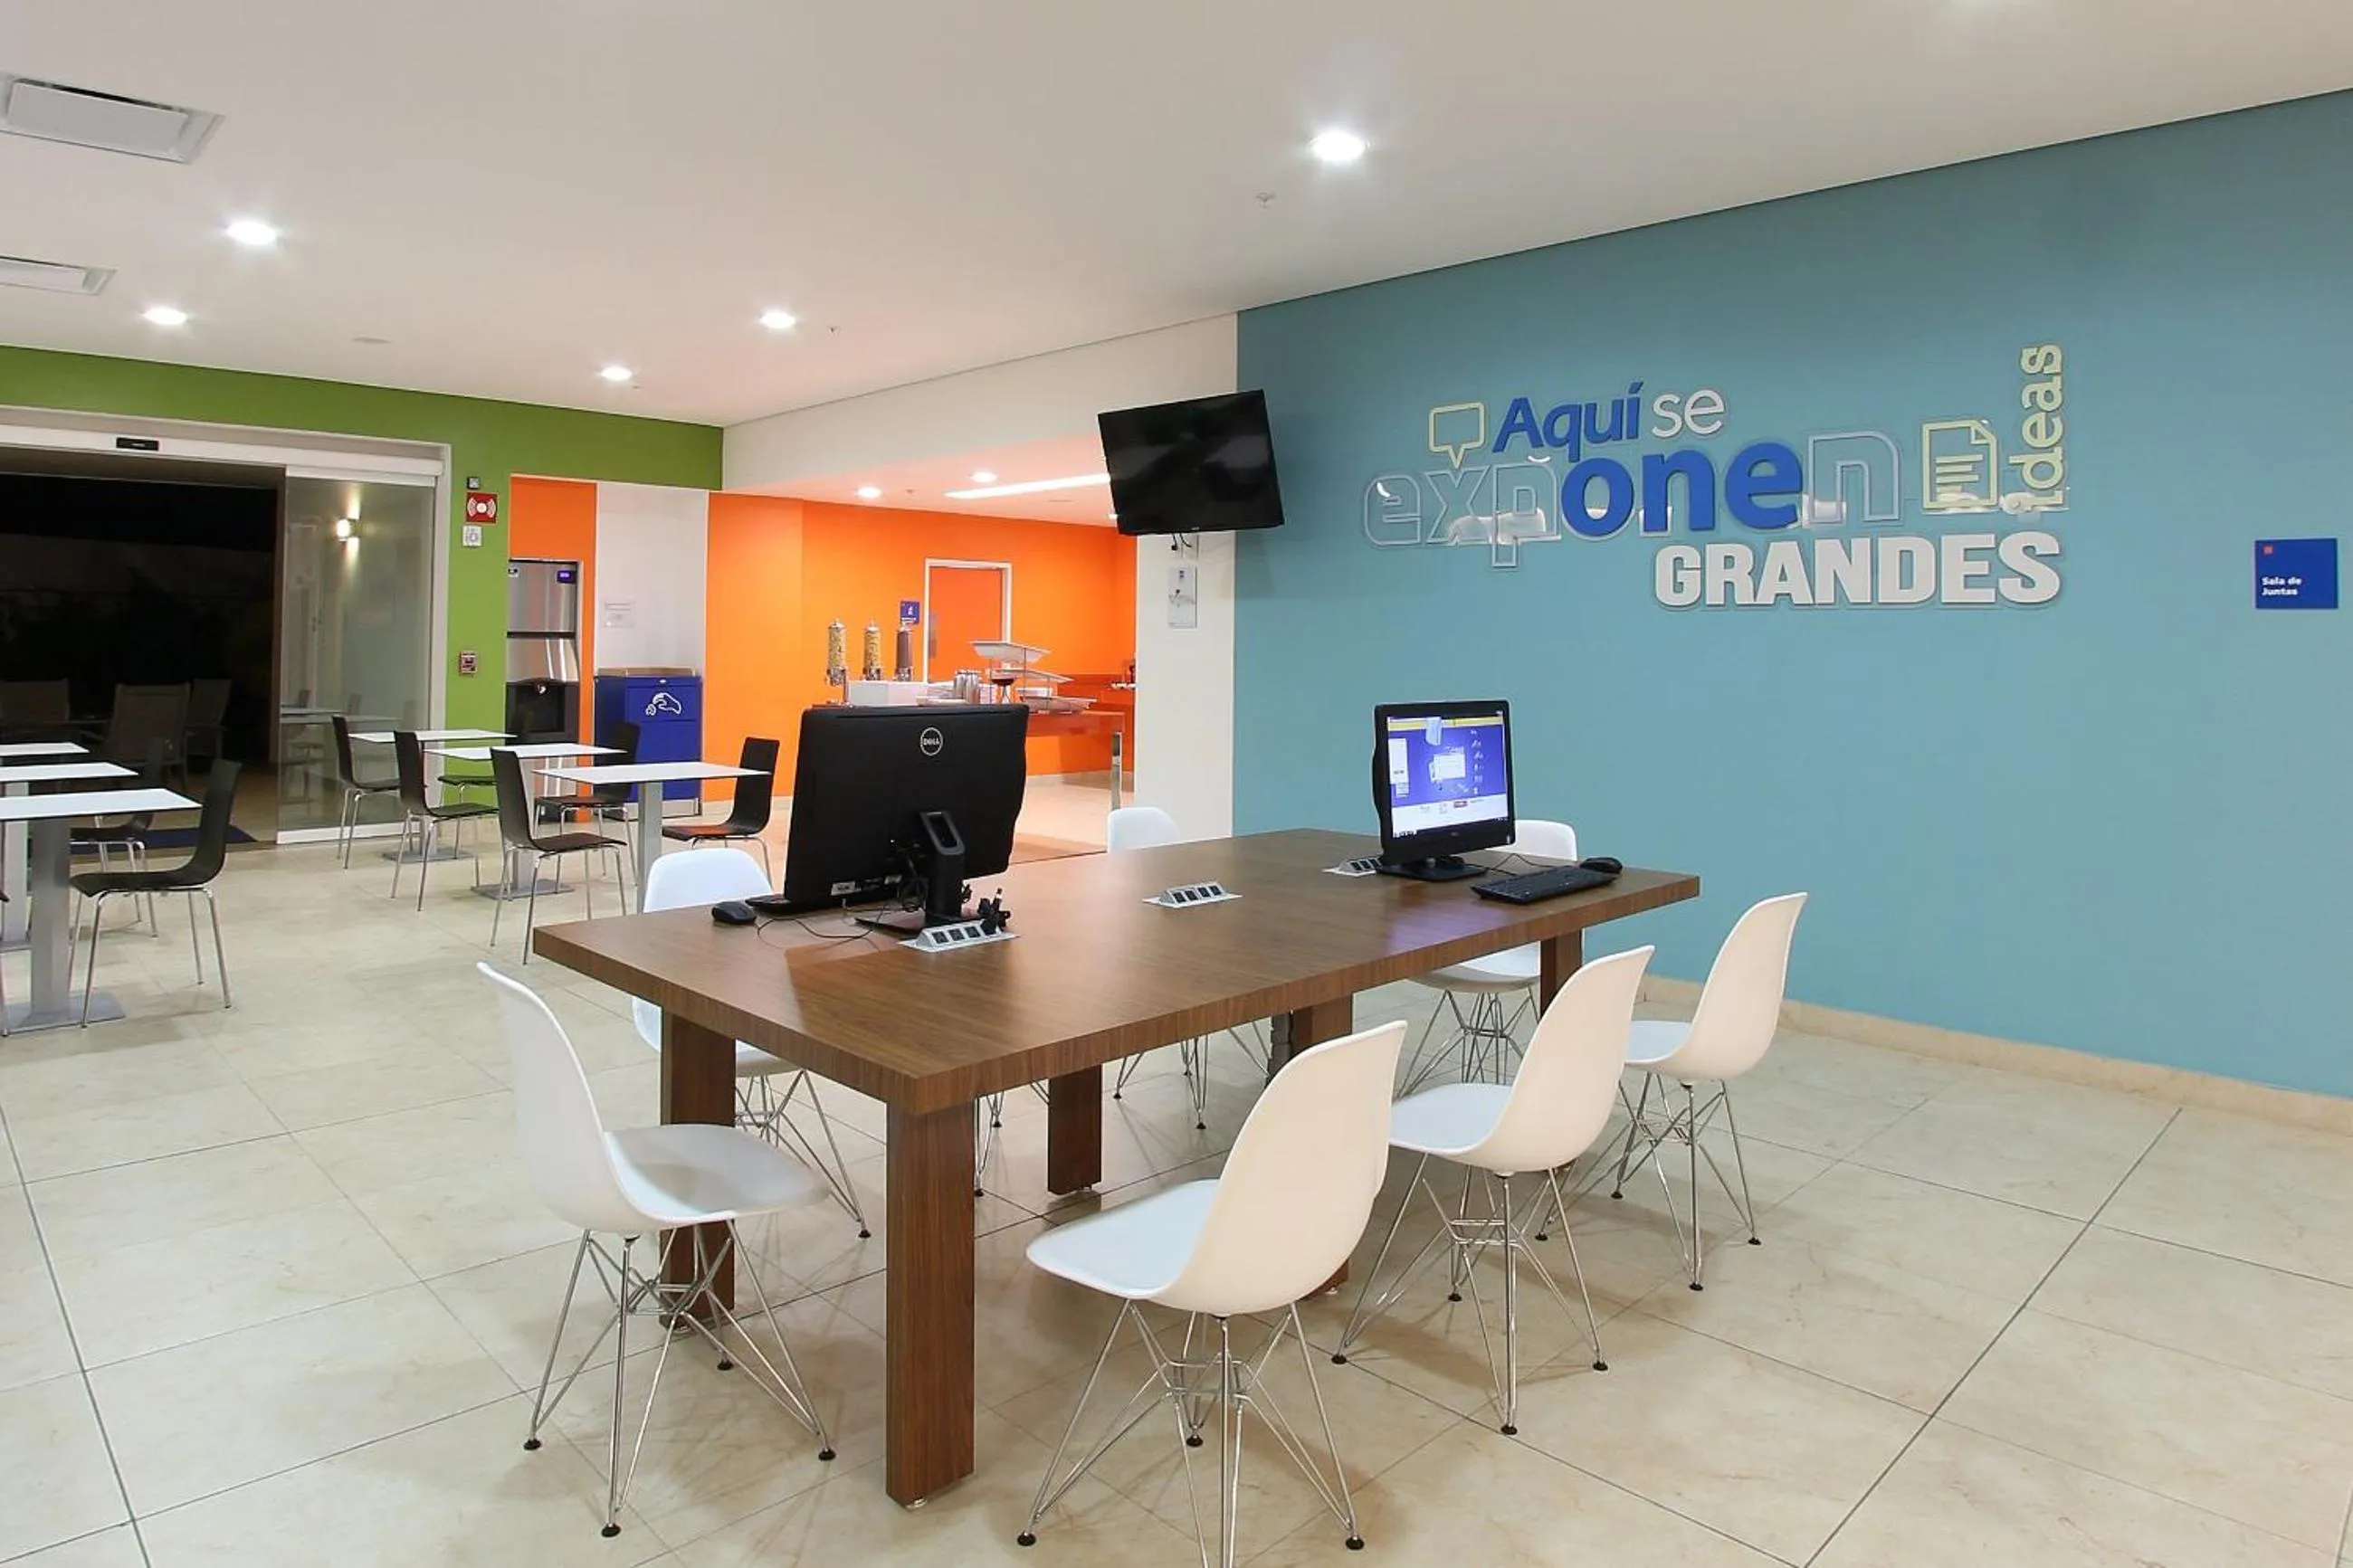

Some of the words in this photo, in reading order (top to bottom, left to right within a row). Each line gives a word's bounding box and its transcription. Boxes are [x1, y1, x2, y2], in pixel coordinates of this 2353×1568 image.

[1492, 380, 1644, 464] Aquí
[1651, 389, 1726, 439] se
[1364, 430, 1900, 568] exponen
[1654, 530, 2062, 607] GRANDES
[2262, 576, 2286, 586] Sala
[2287, 576, 2302, 585] de
[2262, 587, 2299, 596] Juntas
[923, 737, 940, 746] DELL
